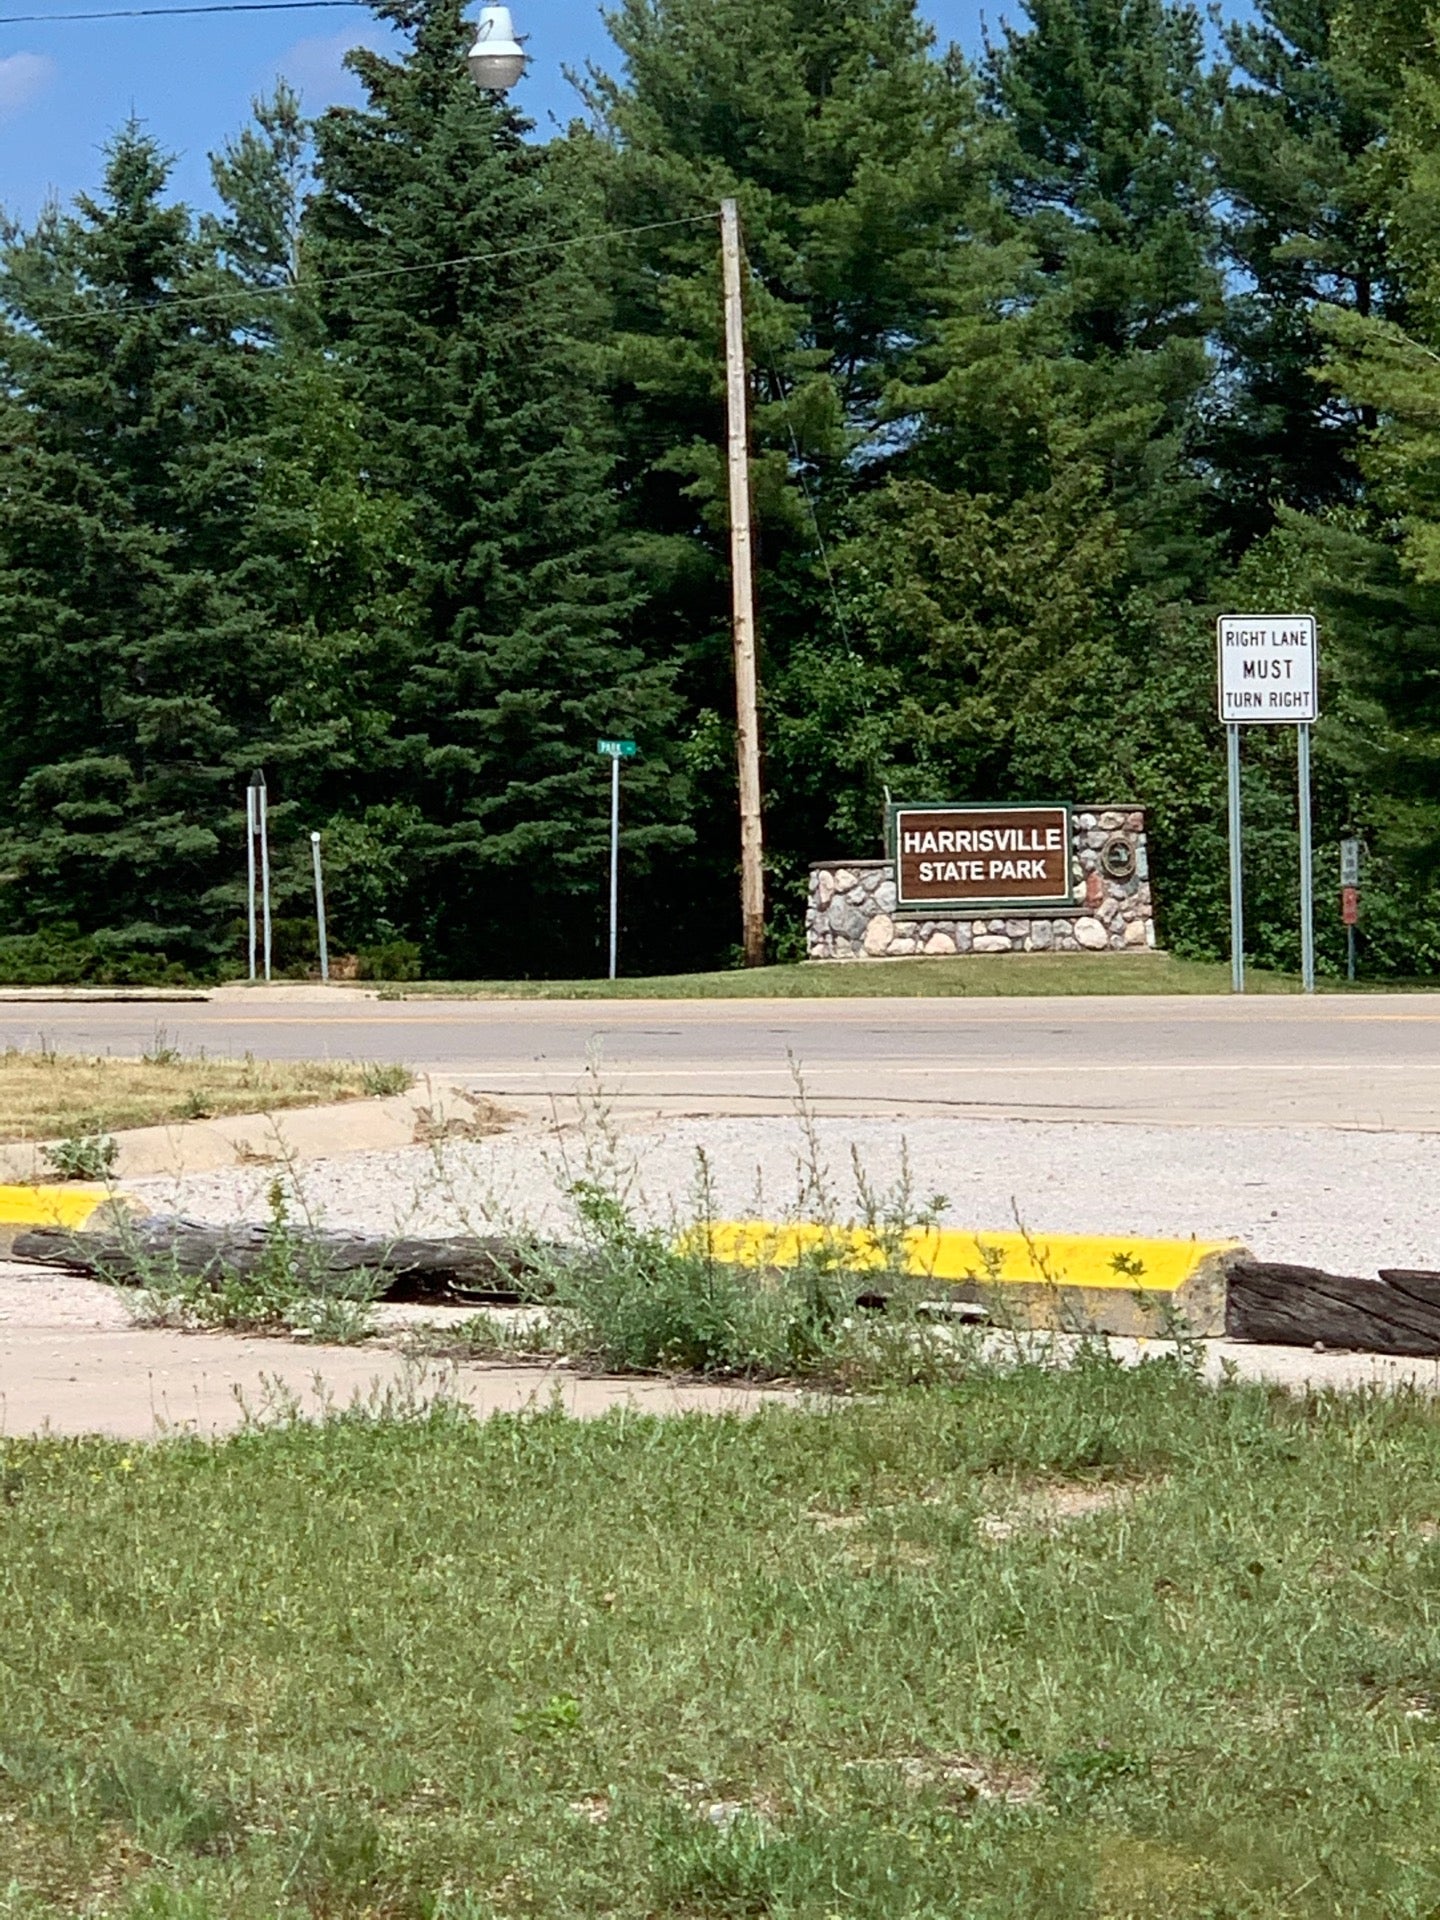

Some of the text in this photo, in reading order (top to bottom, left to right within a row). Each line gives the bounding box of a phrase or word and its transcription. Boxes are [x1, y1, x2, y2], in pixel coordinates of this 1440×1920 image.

[1226, 631, 1308, 646] RIGHT LANE
[1243, 660, 1293, 679] MUST
[1226, 691, 1309, 707] TURN RIGHT
[904, 829, 1062, 853] HARRISVILLE
[919, 860, 1047, 881] STATE PARK
